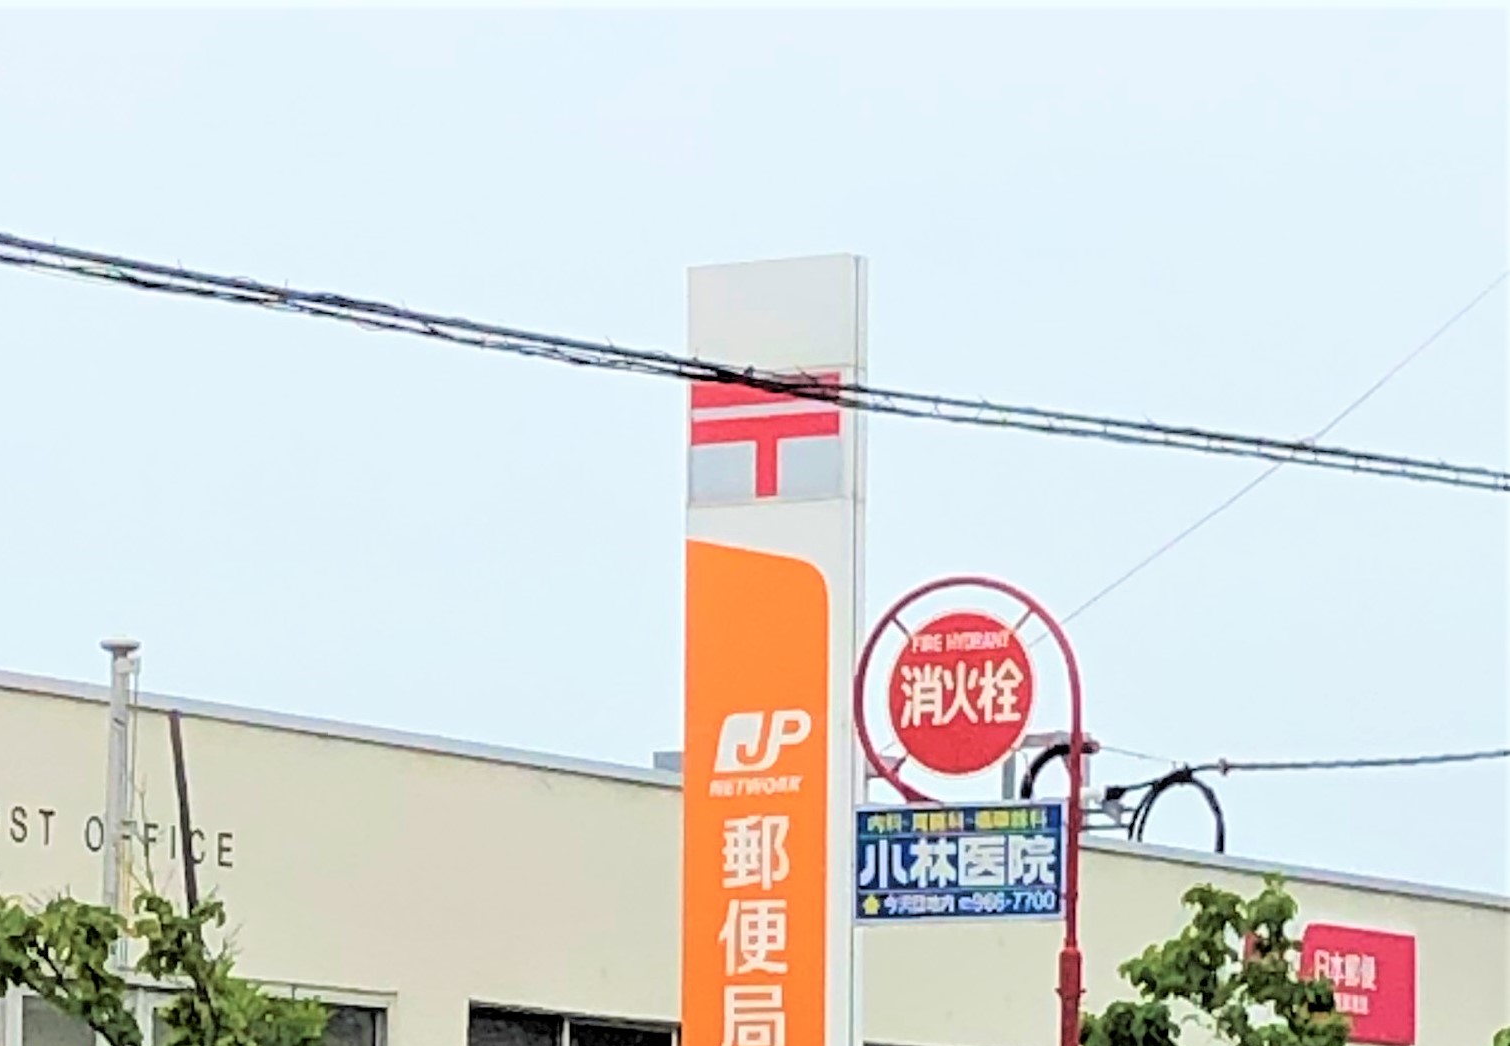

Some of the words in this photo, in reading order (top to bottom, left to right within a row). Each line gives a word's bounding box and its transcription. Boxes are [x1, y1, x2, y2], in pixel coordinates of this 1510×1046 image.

[912, 634, 942, 652] FIRE
[946, 631, 1009, 651] HYDRANT
[901, 658, 1024, 728] 消火栓
[714, 709, 811, 773] JP
[709, 775, 803, 797] NETWORK
[860, 835, 1056, 888] 小林医院
